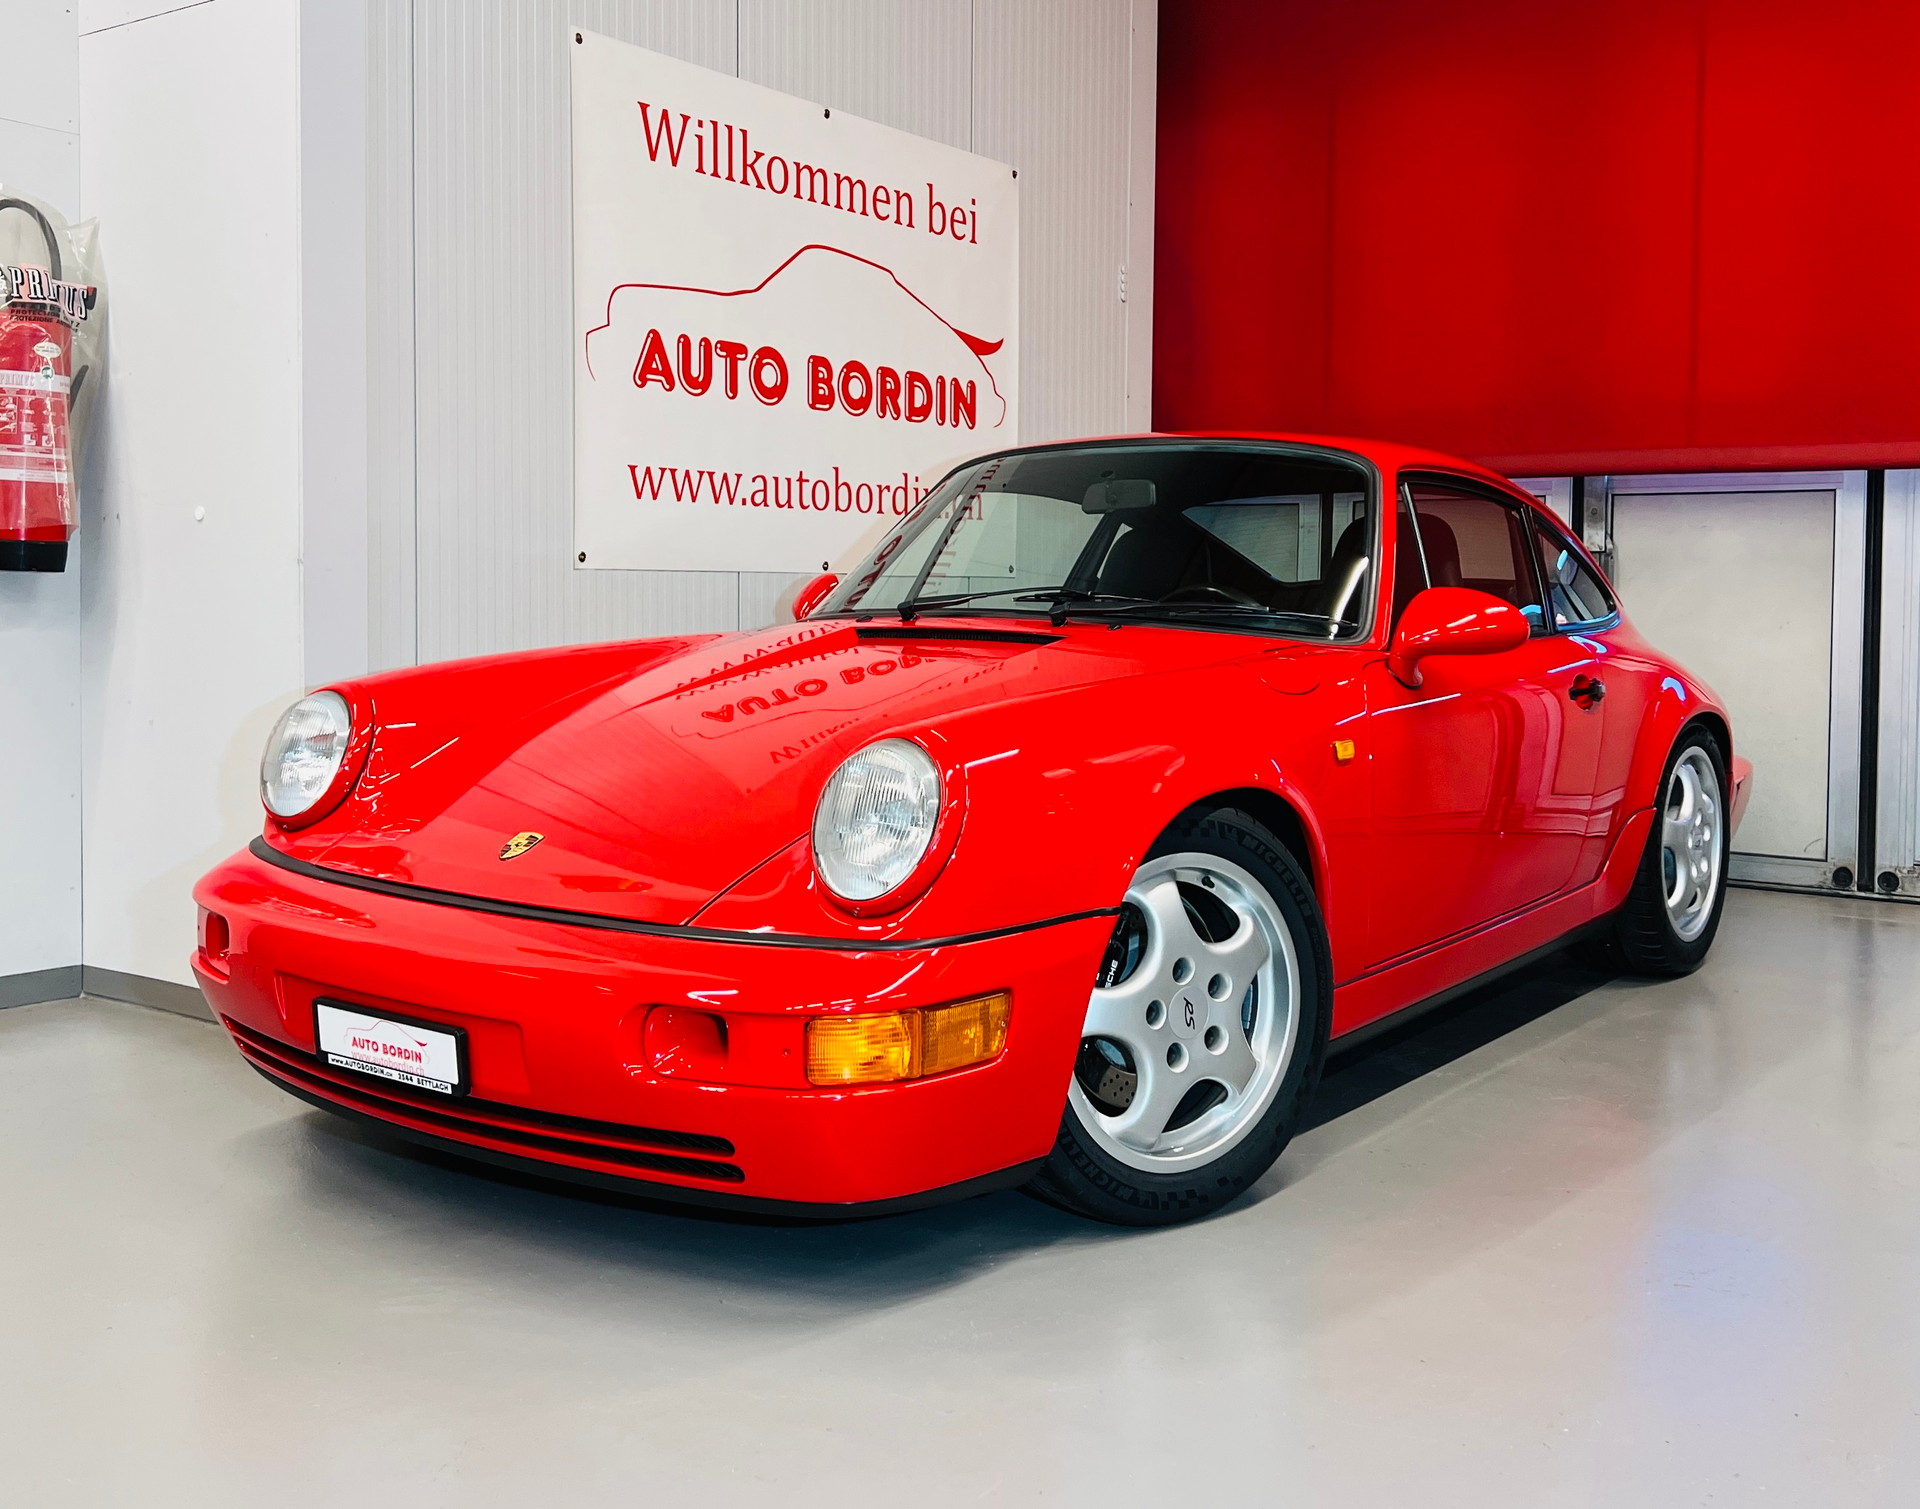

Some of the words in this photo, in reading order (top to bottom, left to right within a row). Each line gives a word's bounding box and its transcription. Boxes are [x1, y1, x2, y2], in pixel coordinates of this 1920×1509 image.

[637, 101, 915, 228] Willkommen
[926, 183, 978, 244] bei
[632, 329, 789, 406] AUTO
[807, 355, 976, 430] BORDIN
[1105, 960, 1119, 989] SCHE
[1183, 997, 1196, 1030] RS
[351, 1051, 425, 1076] www.autobordin.ch
[352, 1036, 379, 1052] AUTO
[382, 1043, 422, 1063] BORDIN
[417, 1078, 449, 1092] BETTLACH
